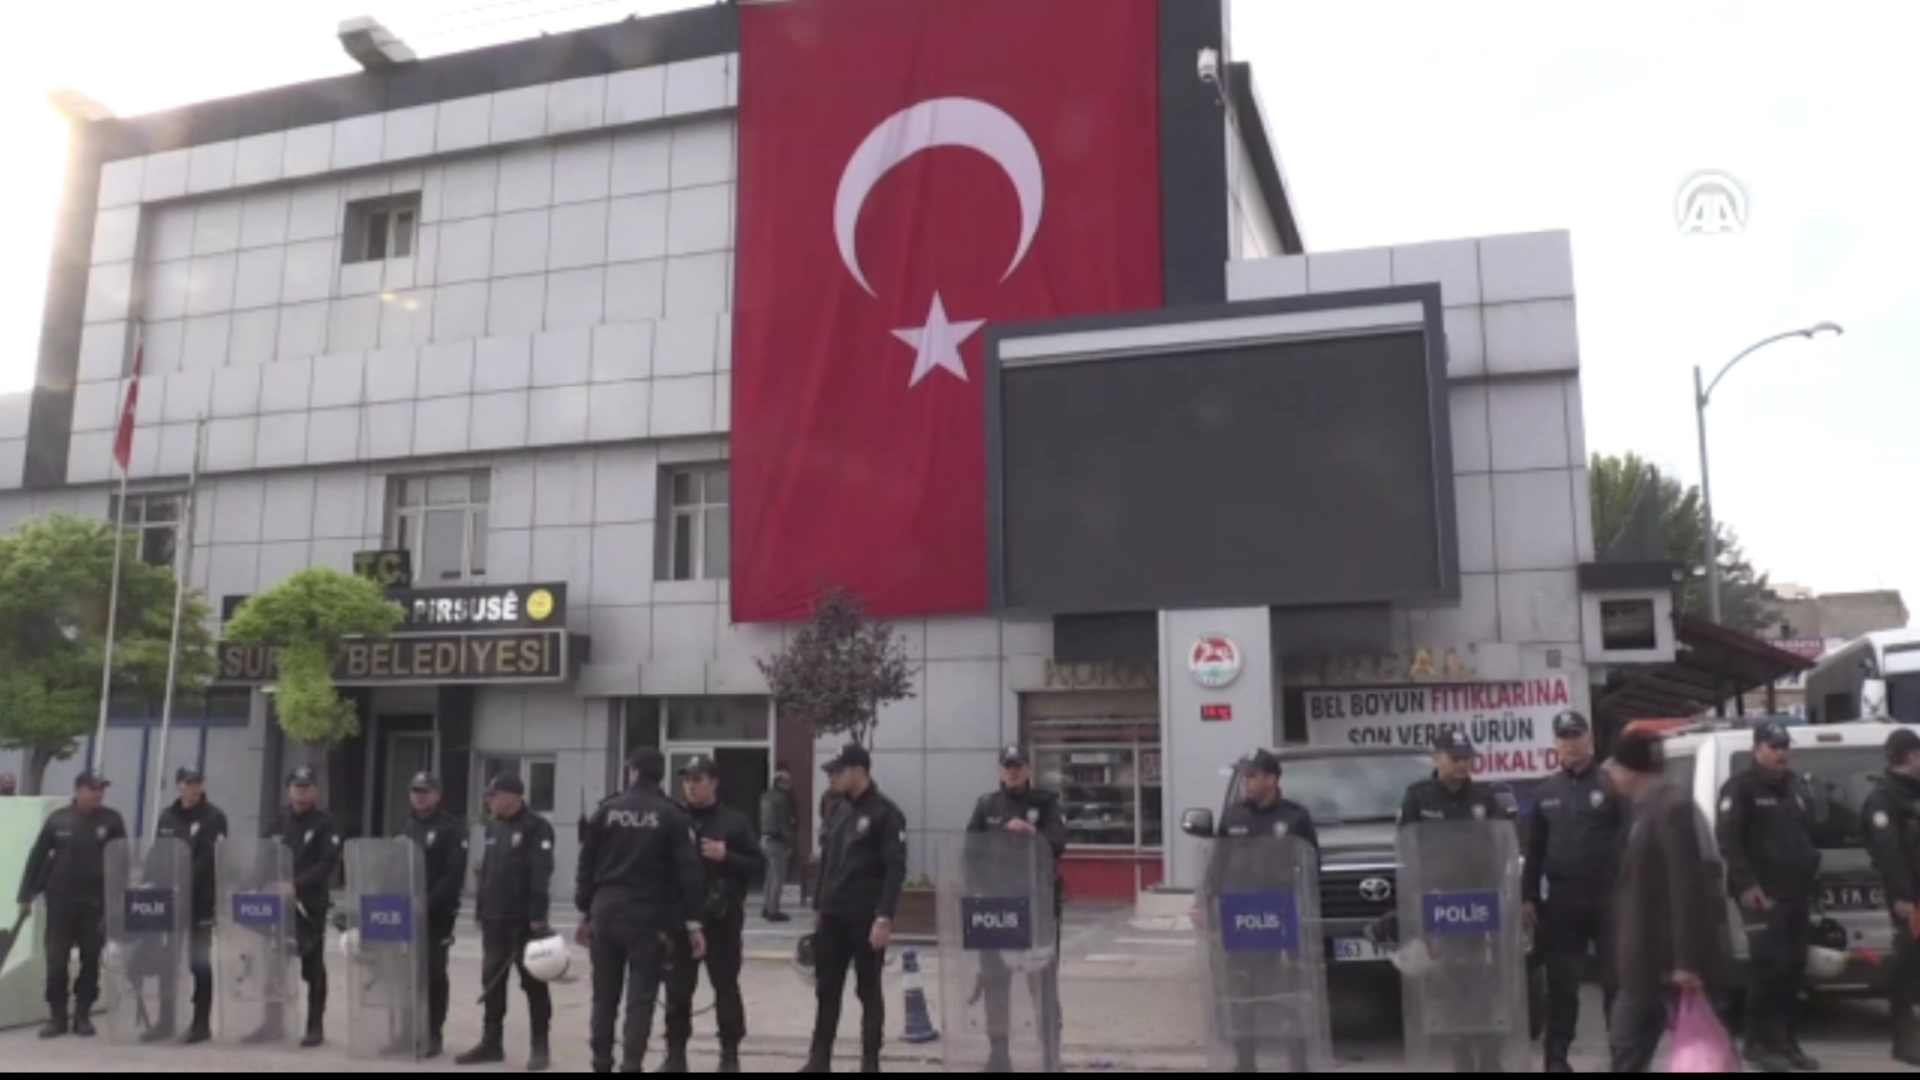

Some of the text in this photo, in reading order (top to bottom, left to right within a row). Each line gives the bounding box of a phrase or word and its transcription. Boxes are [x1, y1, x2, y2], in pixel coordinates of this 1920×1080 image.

[1310, 678, 1568, 720] BEL BOYUN FITIKLARINA
[1471, 711, 1534, 744] ÜRÜN
